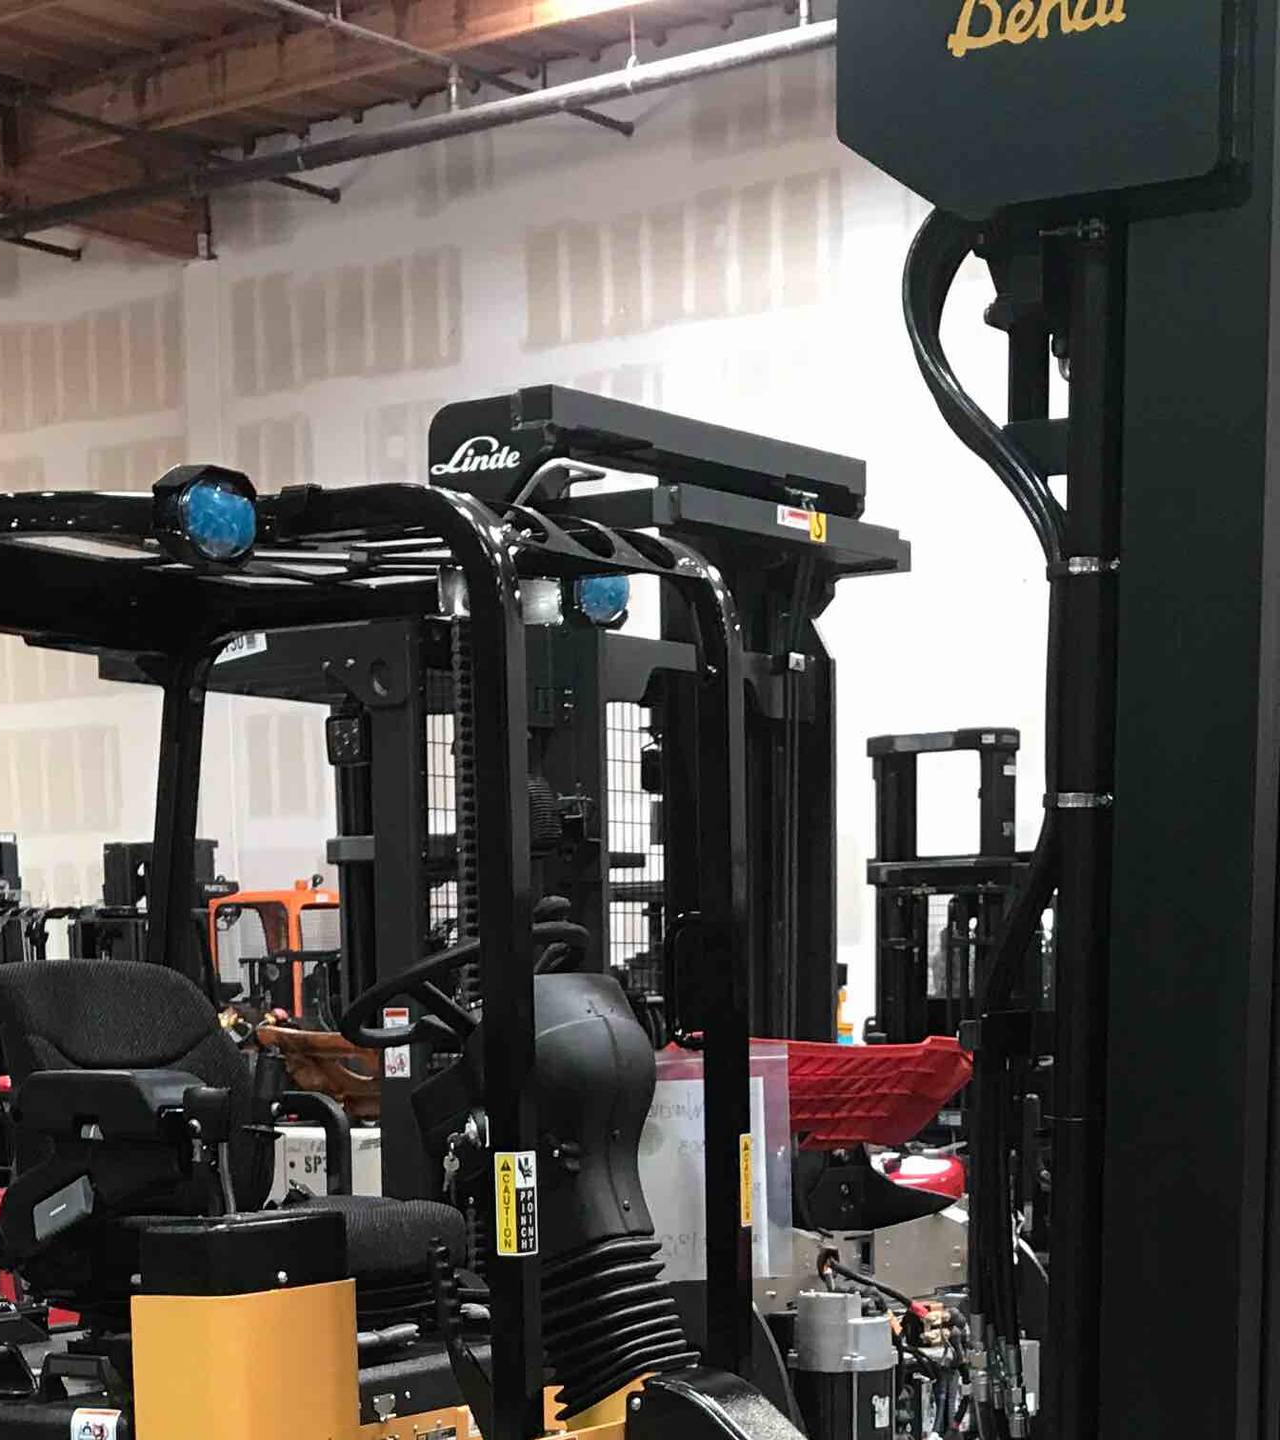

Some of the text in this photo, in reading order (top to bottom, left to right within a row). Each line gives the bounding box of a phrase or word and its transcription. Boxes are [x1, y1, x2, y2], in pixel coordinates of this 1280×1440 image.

[430, 435, 520, 475] Linde
[502, 1174, 512, 1249] CAUTION
[520, 1191, 528, 1249] PINCH
